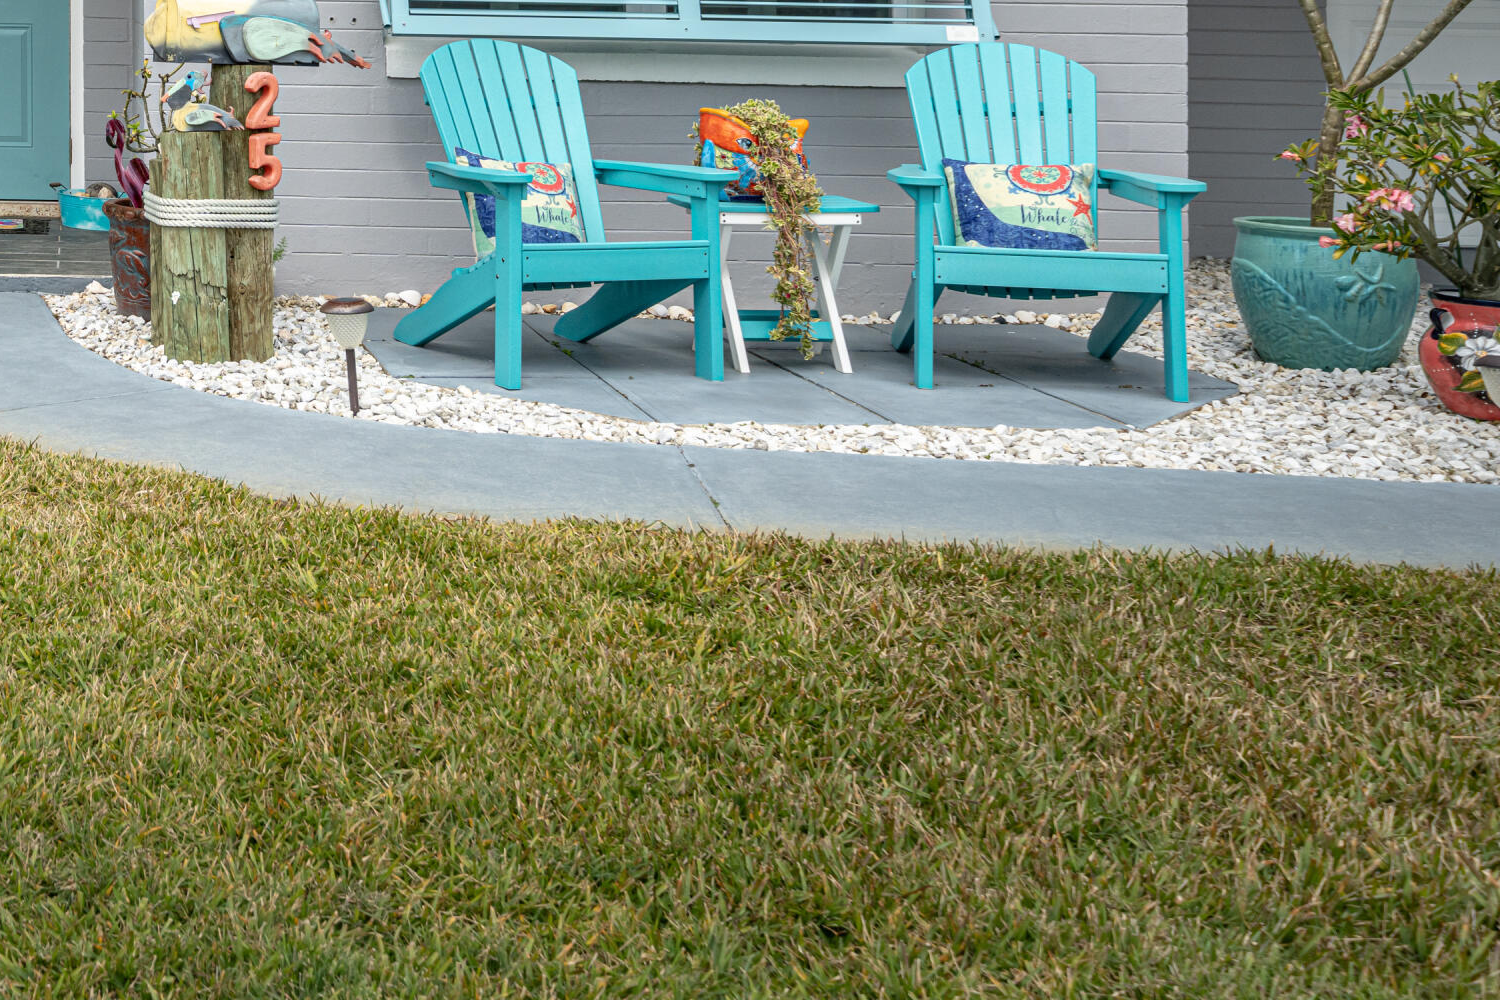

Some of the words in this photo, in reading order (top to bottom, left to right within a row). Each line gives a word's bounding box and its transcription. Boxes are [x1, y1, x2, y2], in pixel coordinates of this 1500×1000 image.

[244, 71, 283, 191] 25
[535, 204, 569, 225] Whale
[1020, 203, 1068, 226] Whale
